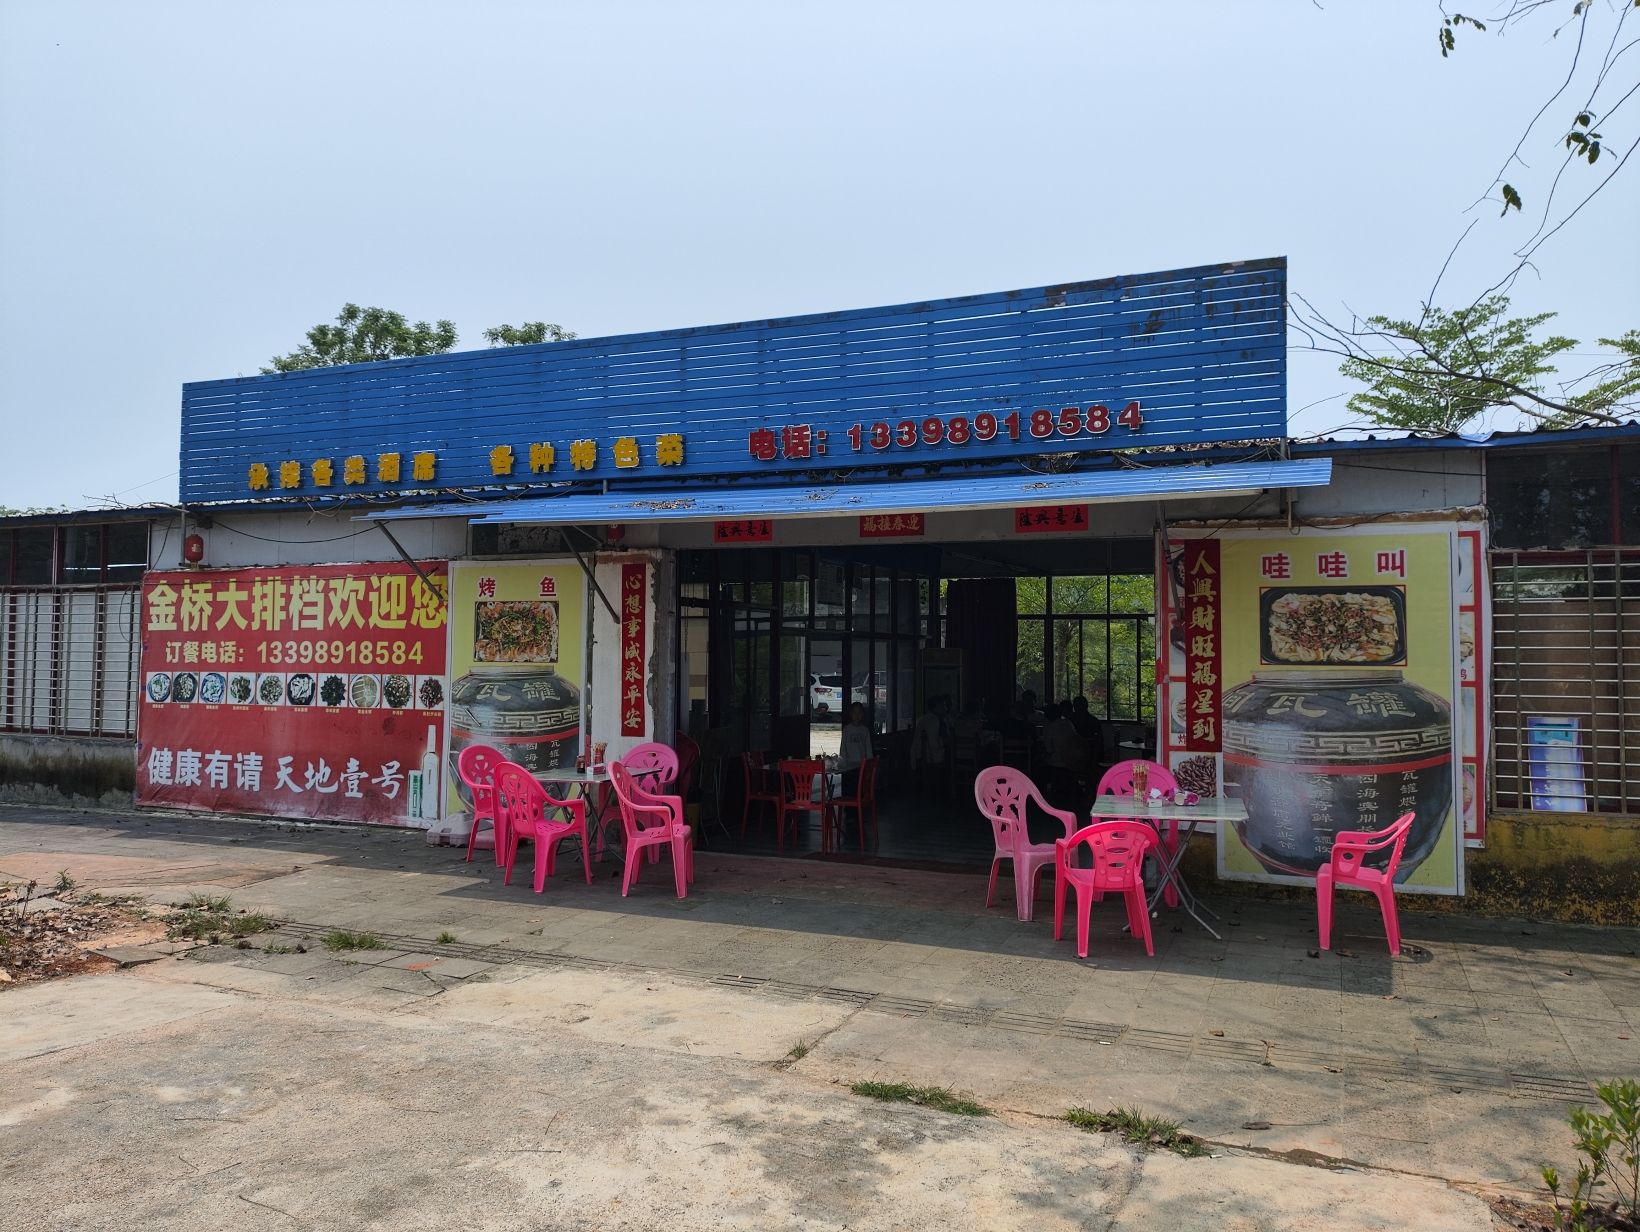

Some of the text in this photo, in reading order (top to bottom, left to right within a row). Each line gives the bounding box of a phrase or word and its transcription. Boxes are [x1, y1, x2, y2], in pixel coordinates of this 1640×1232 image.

[847, 400, 1143, 449] 13398918584
[248, 433, 683, 490] 承接各类酒席 各种特色菜
[1261, 549, 1405, 578] 哇哇叫
[147, 574, 448, 632] 金桥大排档欢迎您
[256, 640, 424, 665] 13398918584
[623, 573, 642, 729] 心想事成永平安
[147, 747, 263, 792] 健康有请
[274, 755, 404, 799] 天地壹号
